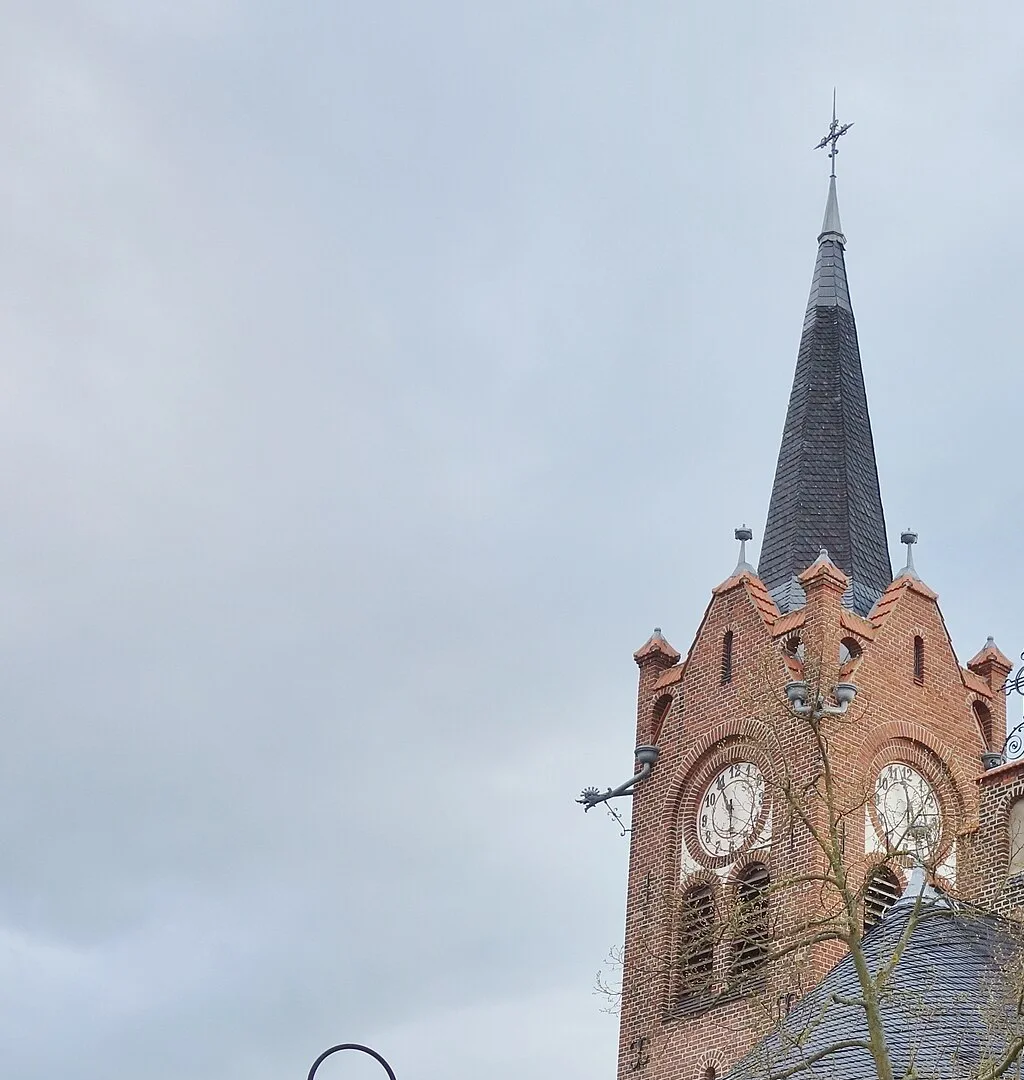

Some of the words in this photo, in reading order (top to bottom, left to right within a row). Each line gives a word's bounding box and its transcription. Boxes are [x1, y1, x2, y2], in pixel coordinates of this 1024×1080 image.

[728, 763, 741, 779] 12
[888, 765, 898, 781] 11
[901, 767, 913, 782] 12
[704, 792, 716, 808] 10
[702, 815, 708, 828] 9
[705, 830, 711, 844] 8
